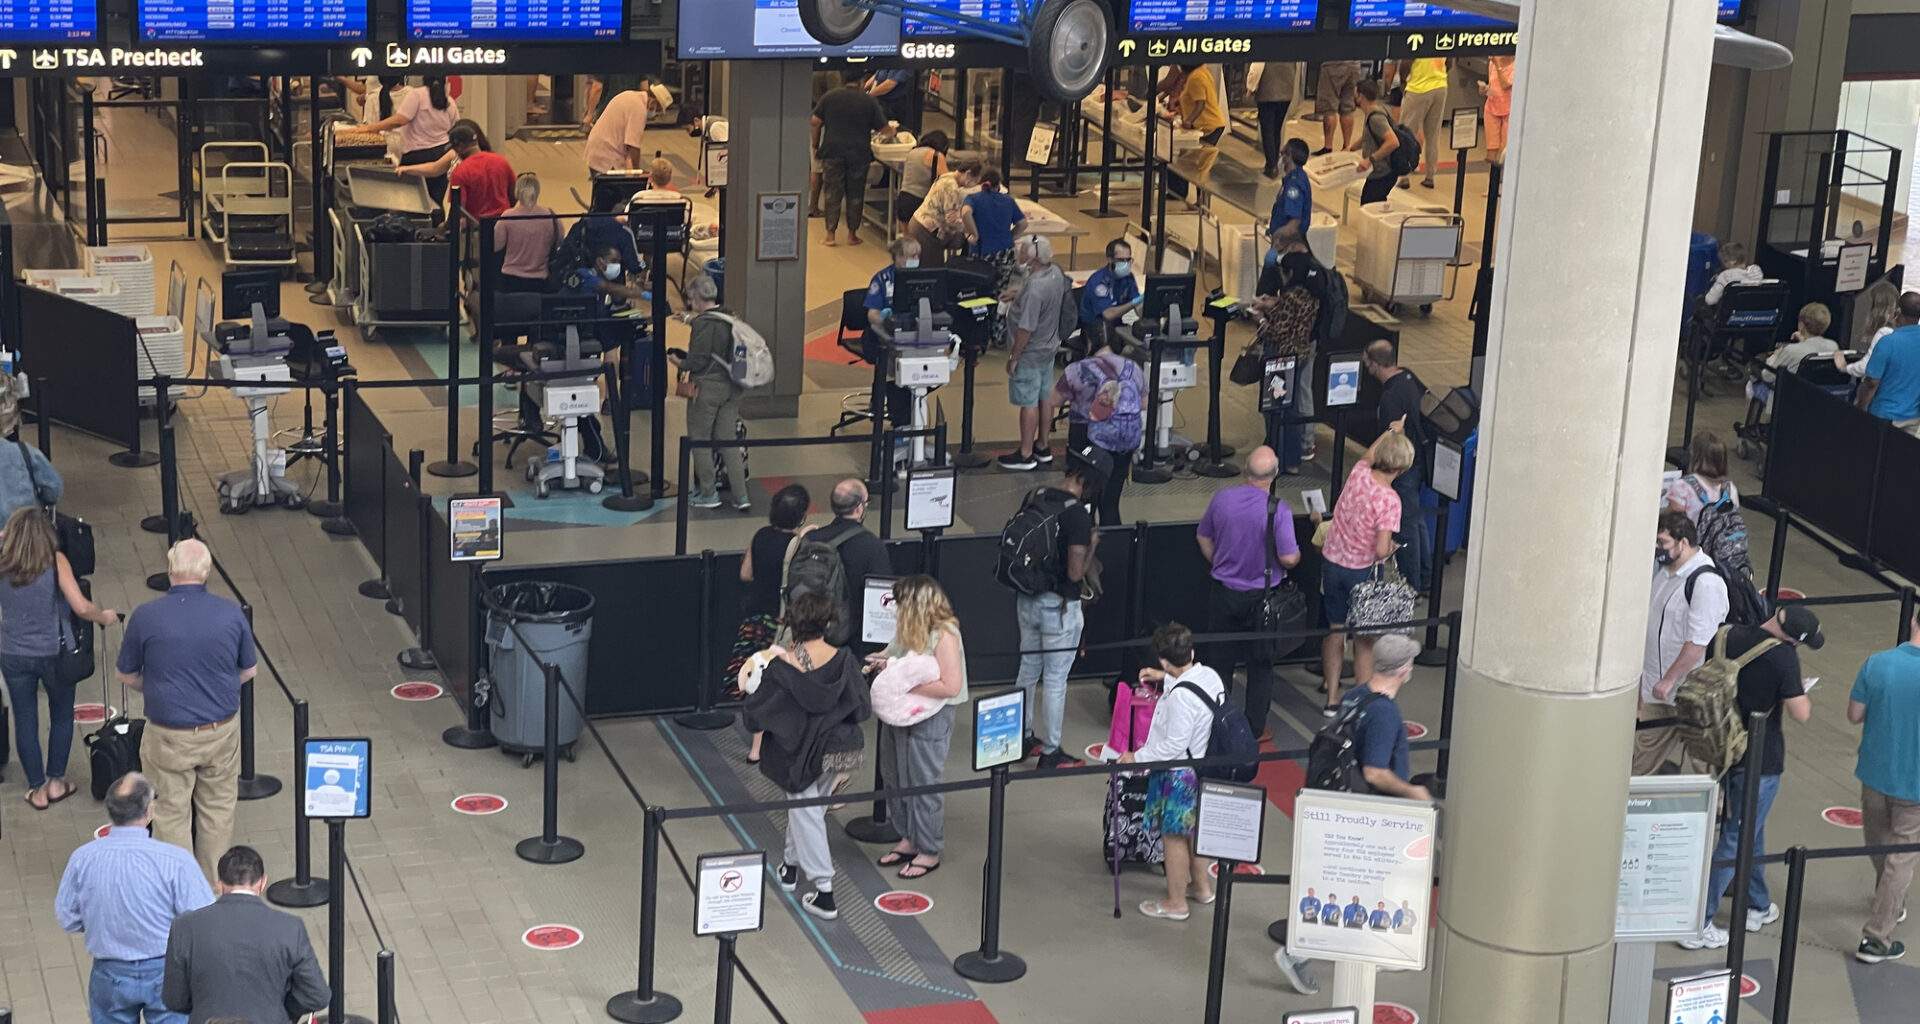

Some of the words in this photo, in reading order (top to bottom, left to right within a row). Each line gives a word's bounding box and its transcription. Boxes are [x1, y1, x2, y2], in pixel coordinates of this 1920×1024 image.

[1172, 38, 1198, 54] All
[1200, 37, 1252, 53] Gates
[1458, 32, 1518, 47] Preferre
[62, 48, 105, 67] TSA
[111, 47, 204, 67] Precheck
[414, 47, 444, 64] All
[447, 46, 506, 64] Gates
[901, 42, 955, 59] Gates
[1265, 362, 1286, 373] REAL
[1286, 361, 1295, 370] ID
[1304, 811, 1330, 822] Still
[1335, 813, 1377, 828] Proudly
[1381, 819, 1424, 833] Serving
